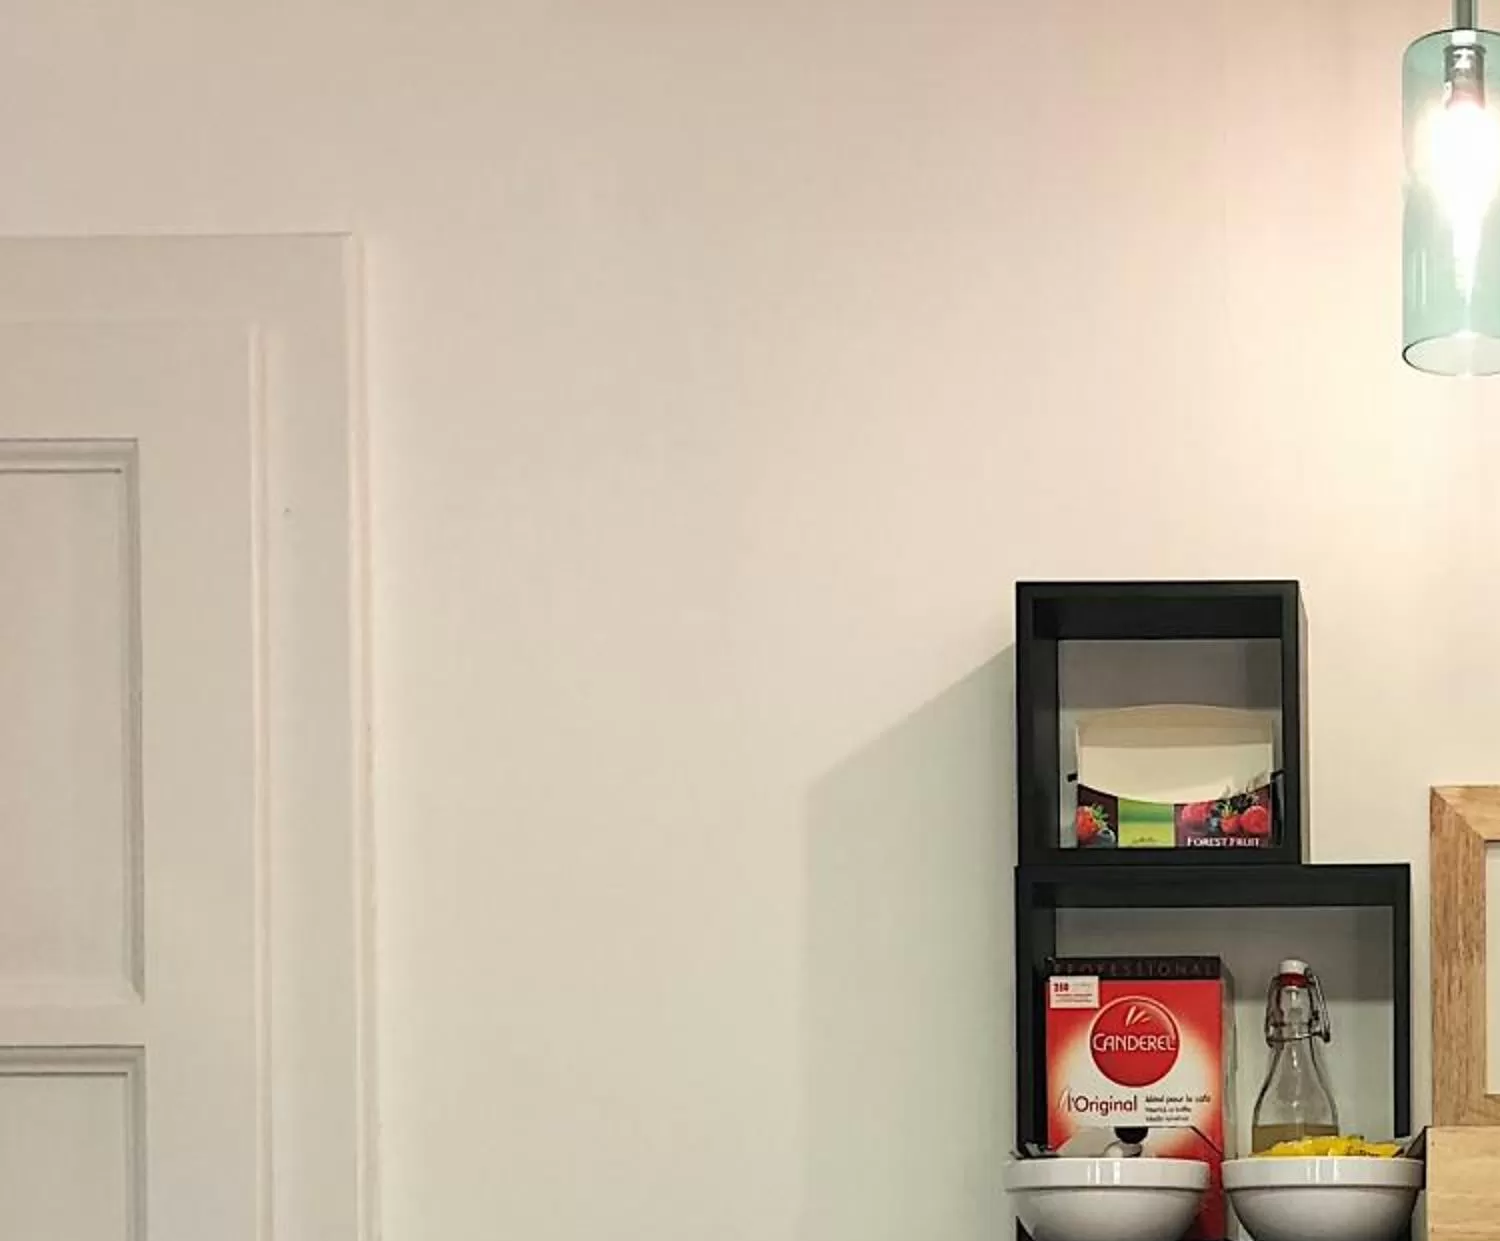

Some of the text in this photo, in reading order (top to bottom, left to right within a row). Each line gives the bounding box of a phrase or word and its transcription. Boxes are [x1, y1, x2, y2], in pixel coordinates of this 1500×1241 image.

[1187, 836, 1260, 848] FOREST FRUIT
[1093, 1032, 1177, 1052] CANDEREL
[1067, 1094, 1138, 1117] l'Original
